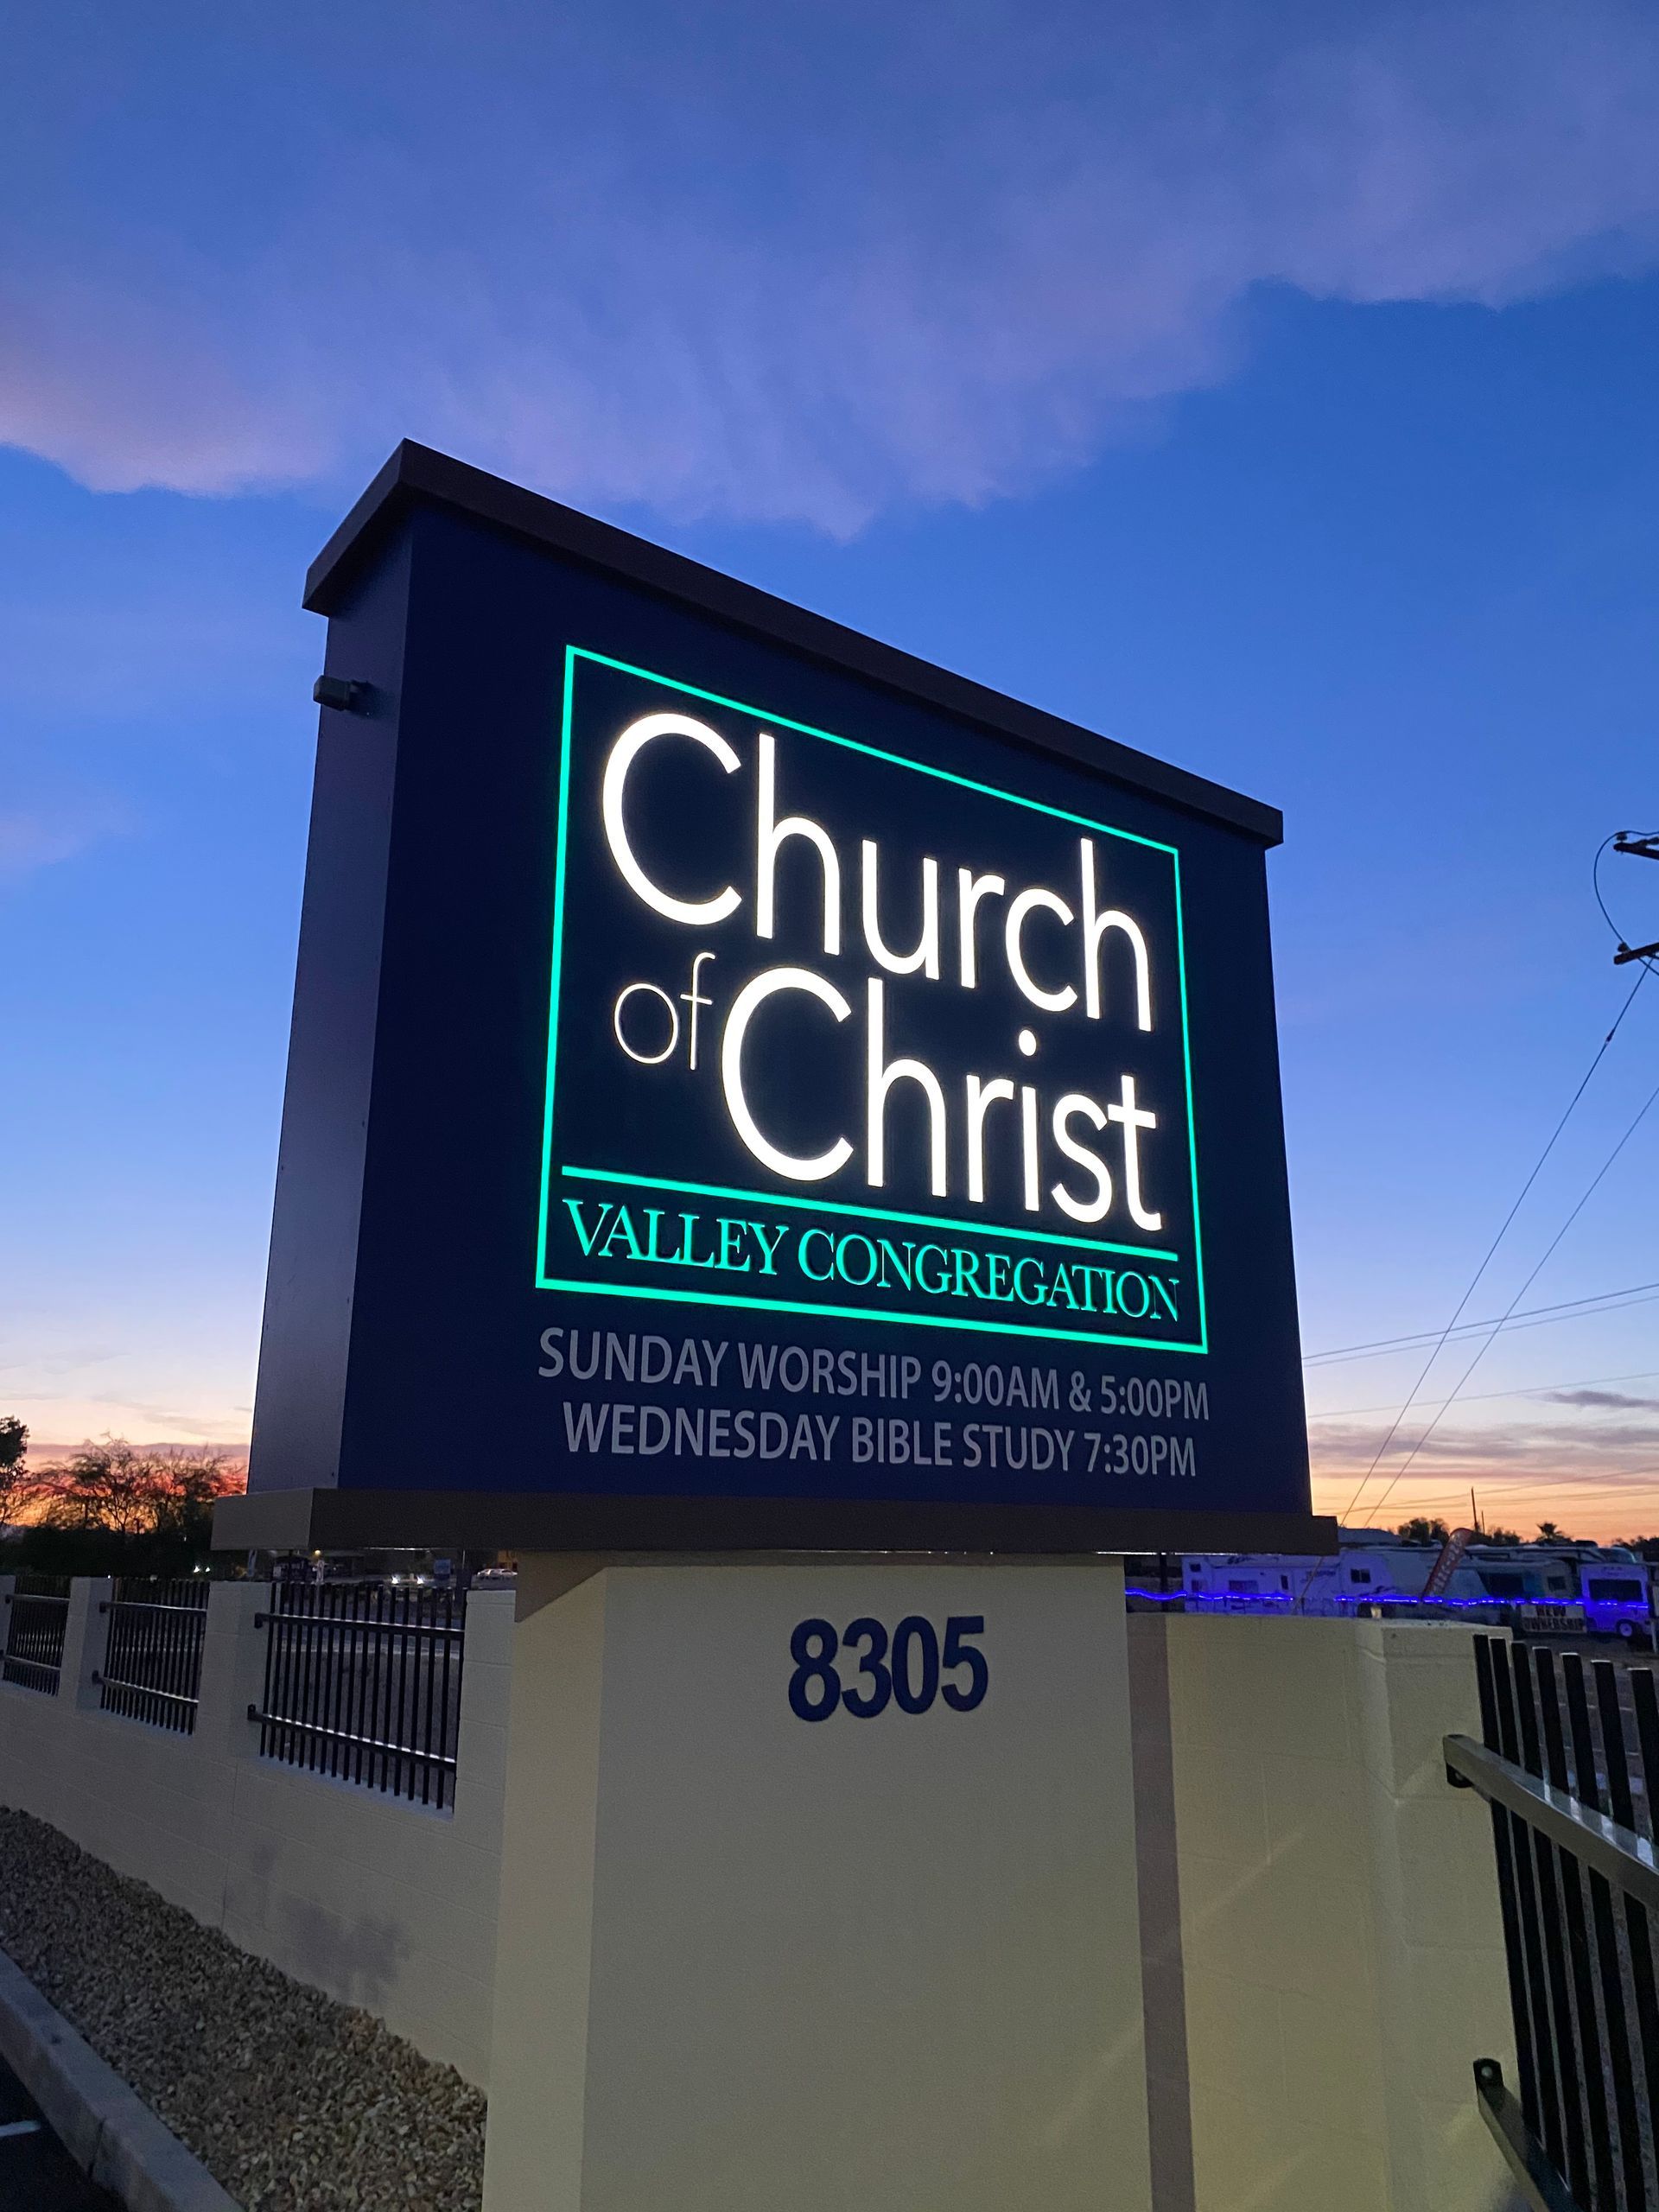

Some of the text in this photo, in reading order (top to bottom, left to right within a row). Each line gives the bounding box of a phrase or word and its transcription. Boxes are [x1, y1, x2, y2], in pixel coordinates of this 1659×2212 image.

[602, 713, 1152, 1033] Church
[613, 951, 716, 1071] of
[721, 967, 1163, 1231] Christ
[562, 1198, 1180, 1322] VALLEY CONGREGATION
[538, 1327, 1210, 1421] SUNDAY WORSHIP 9:00AM & 5:00PM
[563, 1402, 1197, 1478] WEDNESDAY BIBLE STUDY 7:30PM
[787, 1614, 989, 1723] 8305
